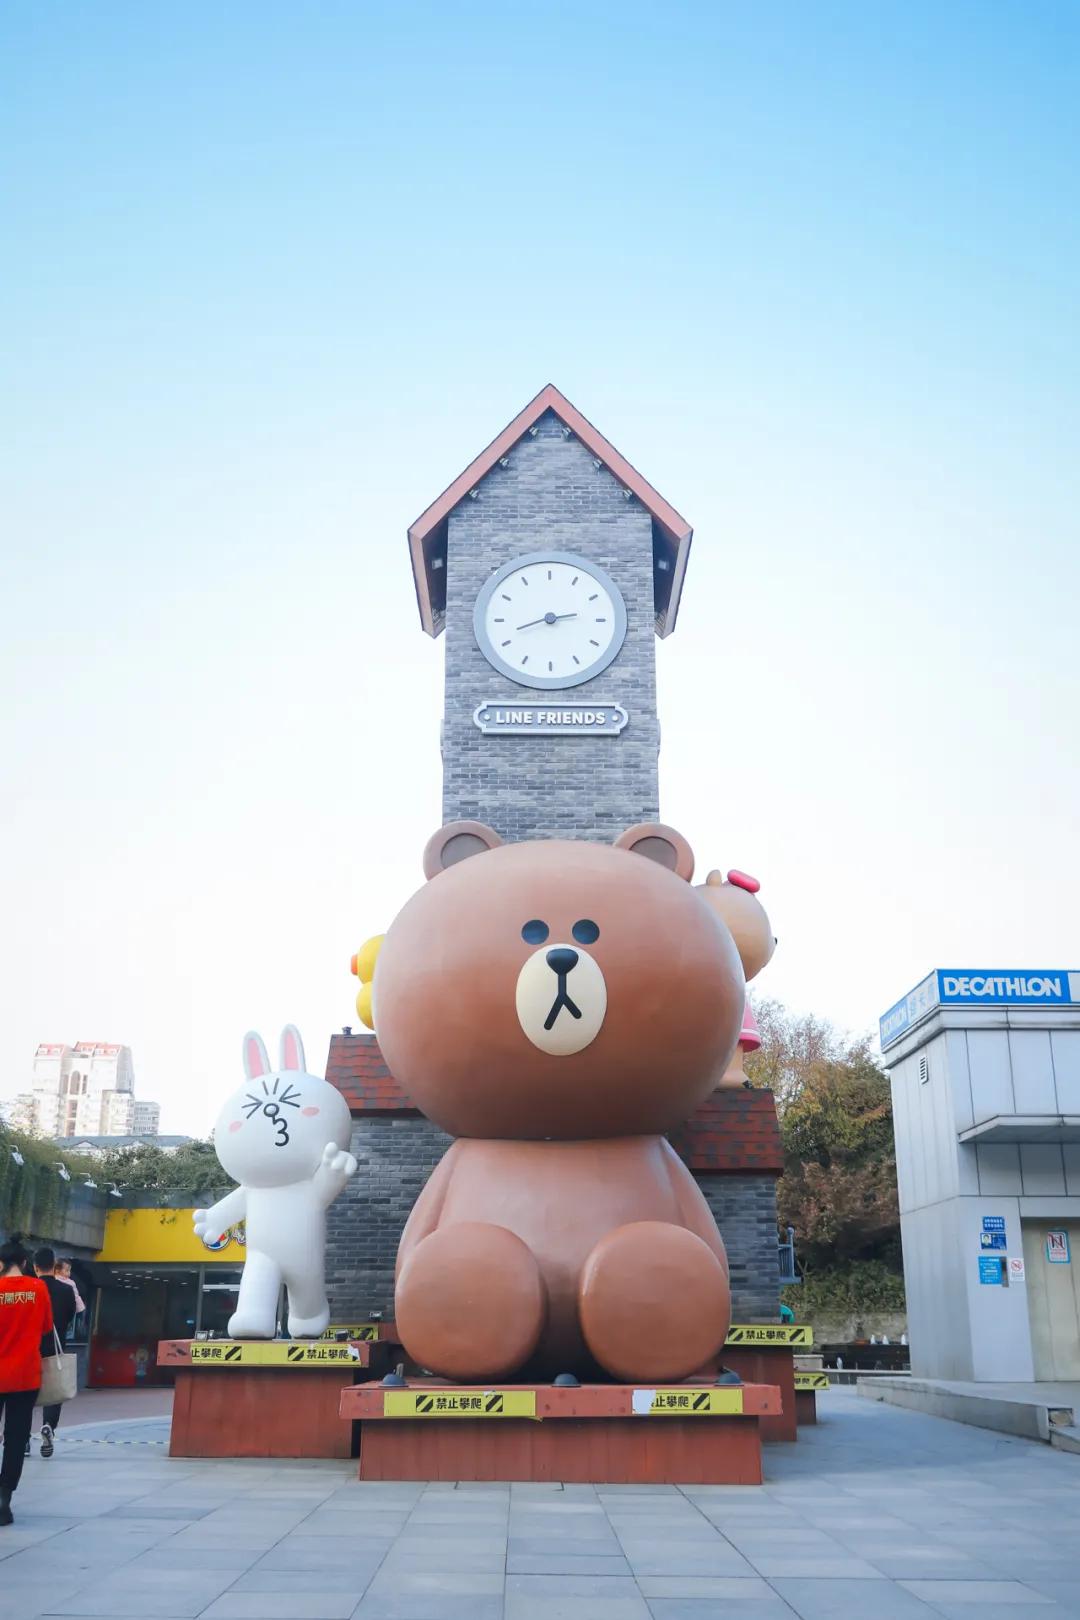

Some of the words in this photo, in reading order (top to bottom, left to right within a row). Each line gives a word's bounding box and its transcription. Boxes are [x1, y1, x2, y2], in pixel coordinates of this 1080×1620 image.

[495, 711, 533, 724] LINE
[537, 711, 606, 725] FRIENDS
[943, 977, 1062, 997] DECATHLON
[745, 1330, 787, 1340] 禁止攀爬
[306, 1348, 349, 1359] 禁止攀爬
[436, 1397, 482, 1410] 禁止攀爬
[651, 1395, 689, 1408] 止攀爬
